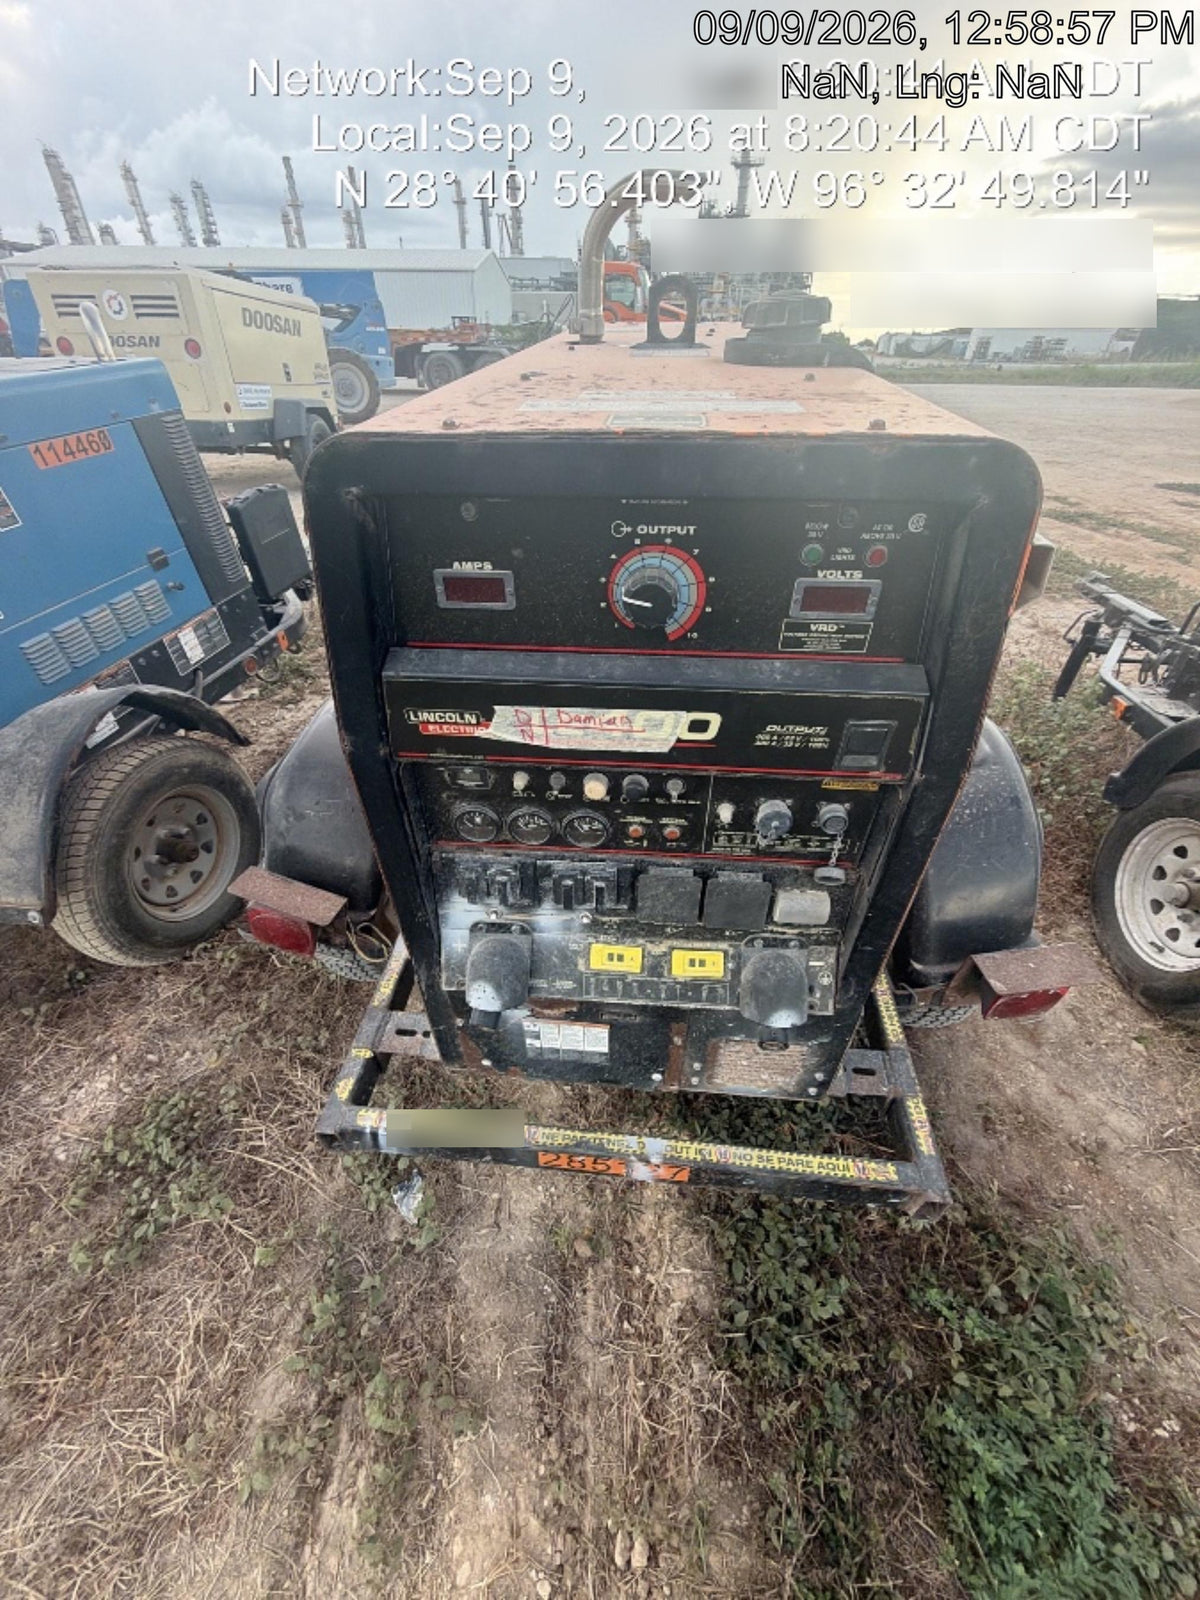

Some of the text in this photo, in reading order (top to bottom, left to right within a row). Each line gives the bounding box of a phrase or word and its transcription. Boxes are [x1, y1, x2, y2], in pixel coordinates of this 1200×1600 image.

[241, 307, 302, 337] DOOSAN
[636, 525, 698, 535] OUTPUT
[452, 561, 494, 571] AMPS
[817, 570, 863, 579] VOLTS
[409, 710, 478, 724] LINCOLN
[778, 1156, 813, 1169] PARE
[817, 1162, 851, 1174] AQUI
